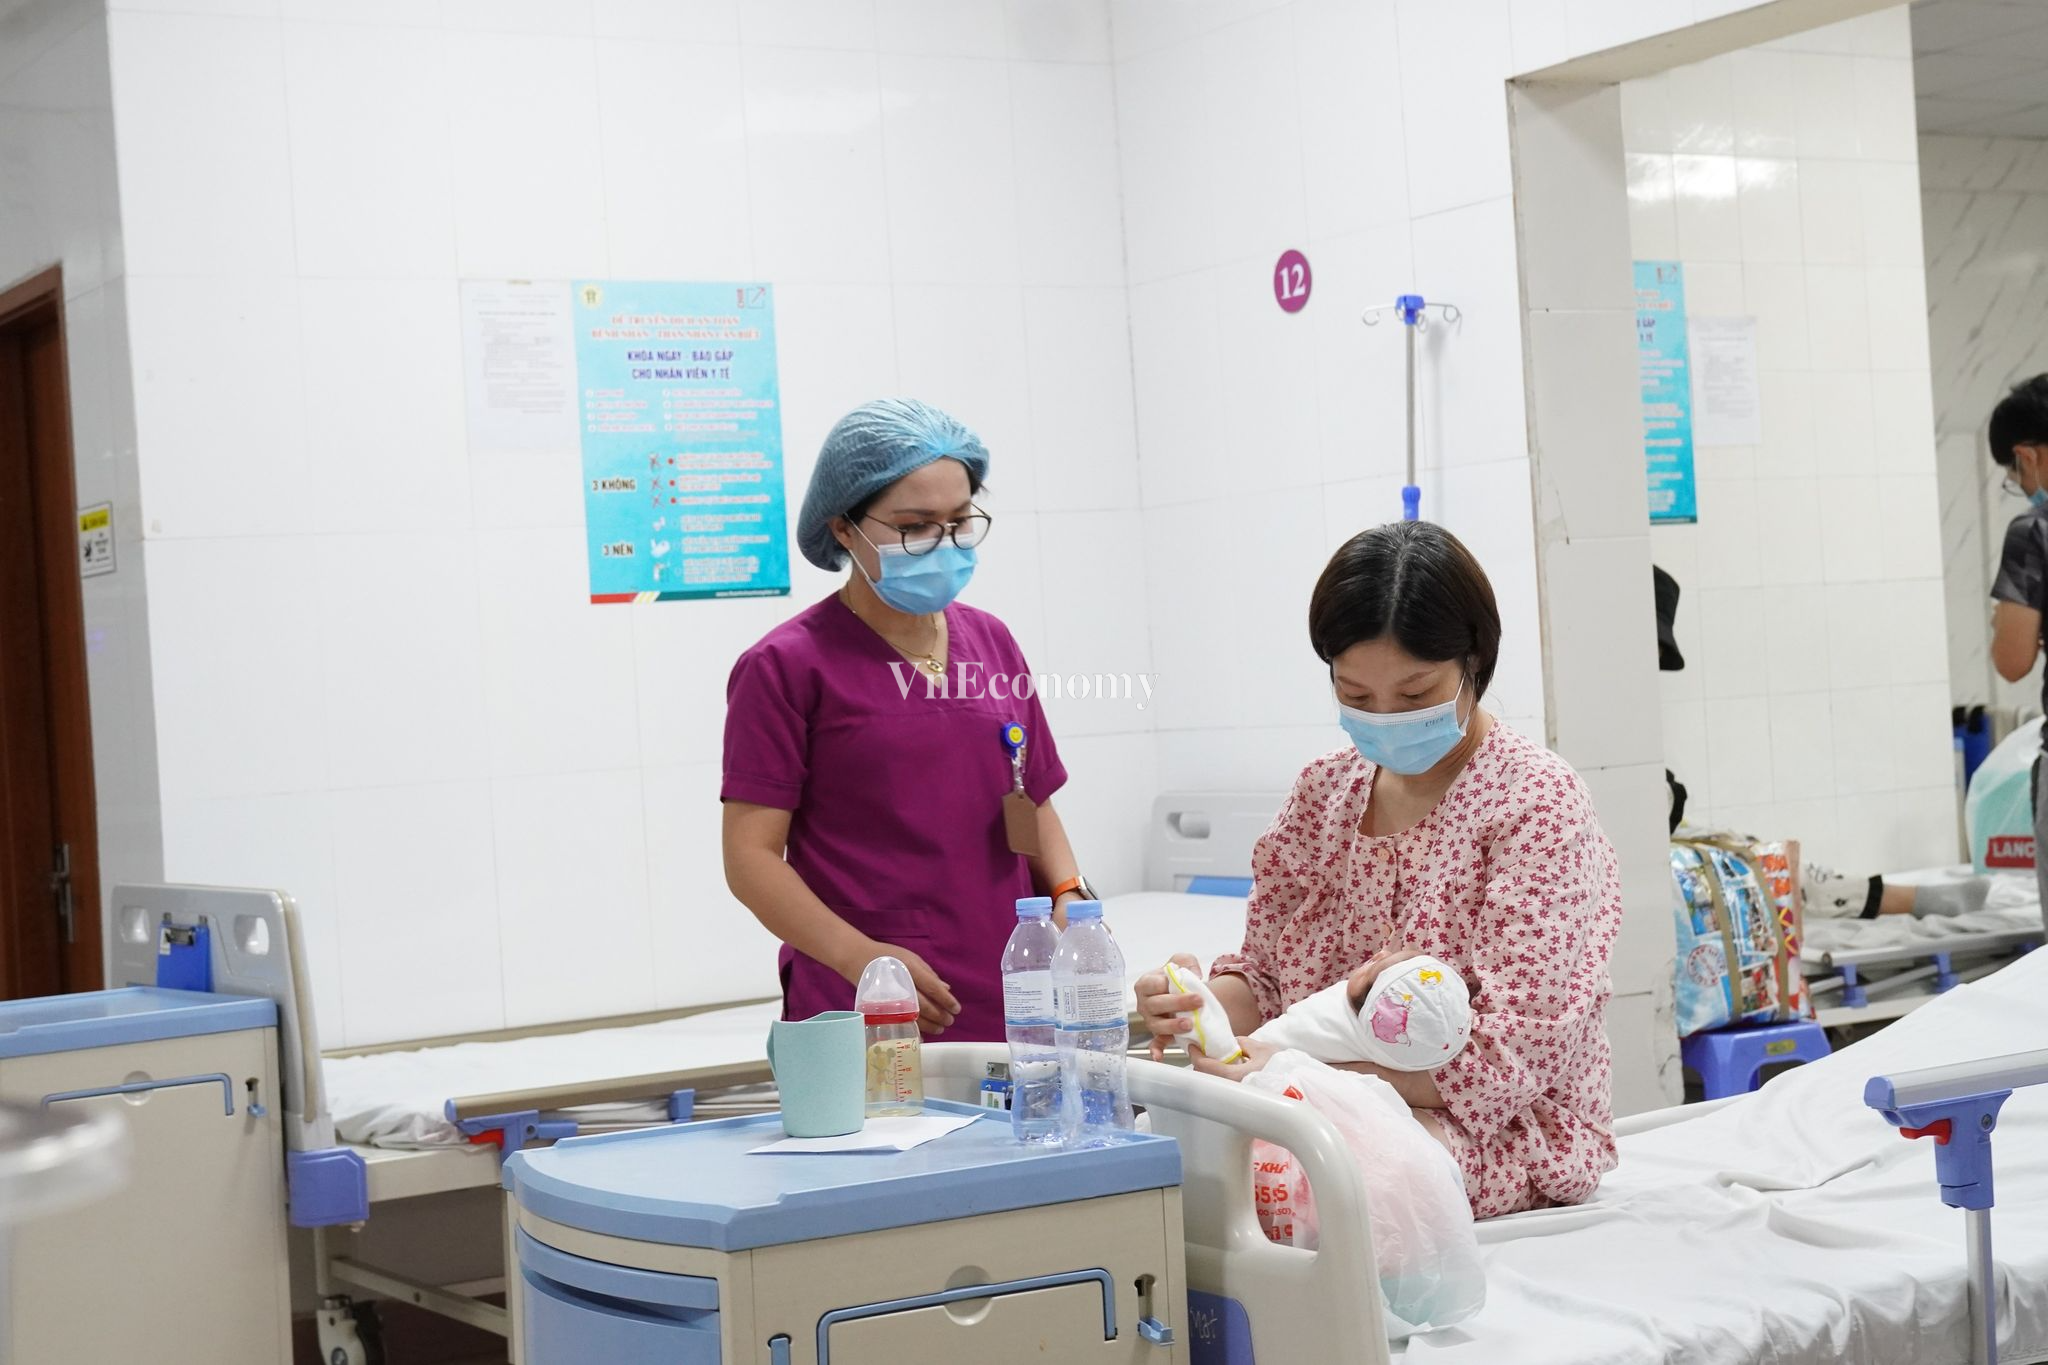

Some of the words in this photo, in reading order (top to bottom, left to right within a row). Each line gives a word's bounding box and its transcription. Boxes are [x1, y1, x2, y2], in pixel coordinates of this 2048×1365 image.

[1279, 263, 1307, 300] 12
[632, 368, 652, 380] CHO
[711, 368, 716, 379] Y
[602, 477, 636, 490] KHÔNG
